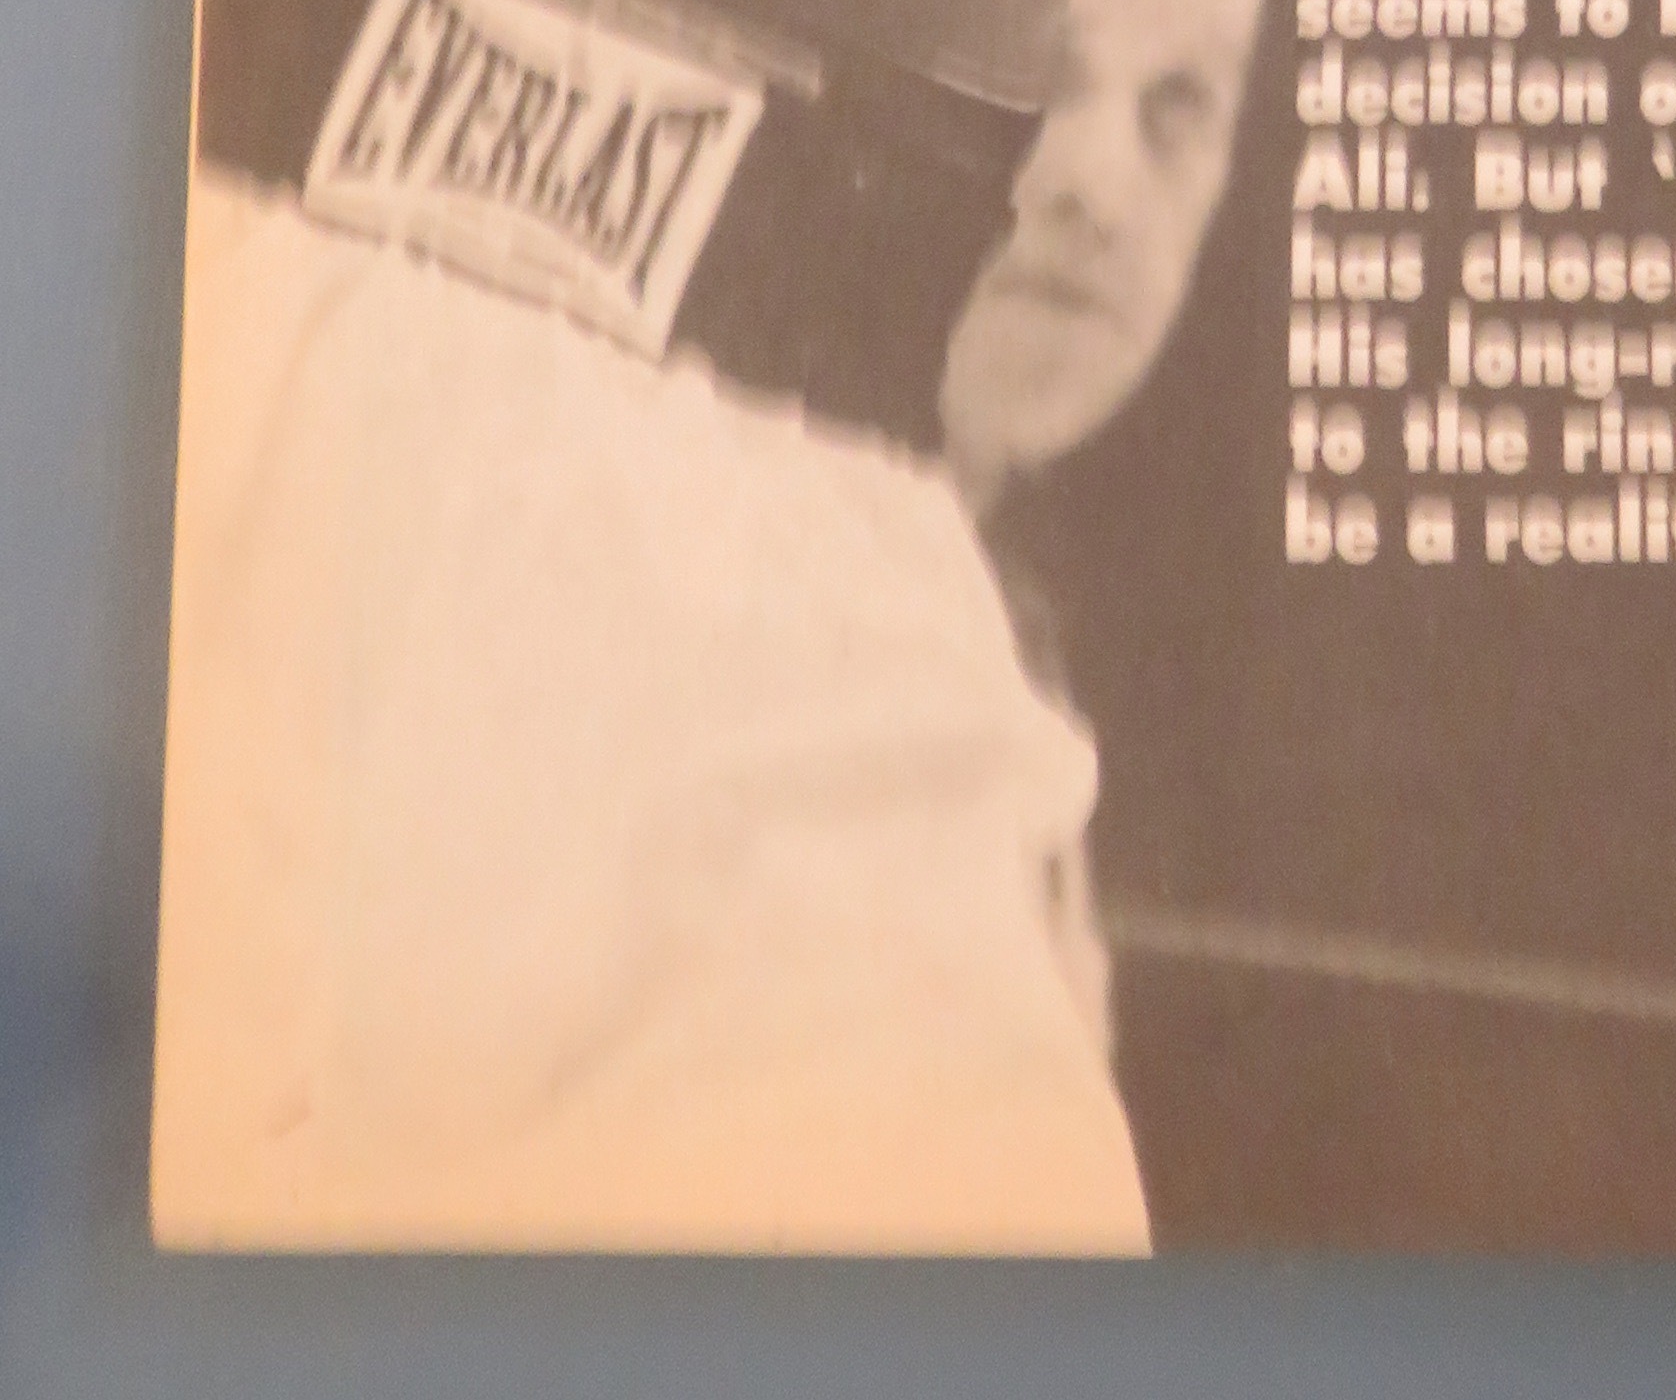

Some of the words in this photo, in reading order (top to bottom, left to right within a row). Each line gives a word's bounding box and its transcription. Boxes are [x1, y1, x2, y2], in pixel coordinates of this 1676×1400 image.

[1297, 38, 1608, 125] decision
[1293, 128, 1430, 211] Ali.
[1475, 128, 1607, 211] But
[1290, 213, 1423, 300] has
[1288, 299, 1409, 388] His
[1290, 400, 1365, 475] to
[1405, 386, 1530, 475] the
[1285, 474, 1379, 565] be
[1406, 493, 1455, 565] a
